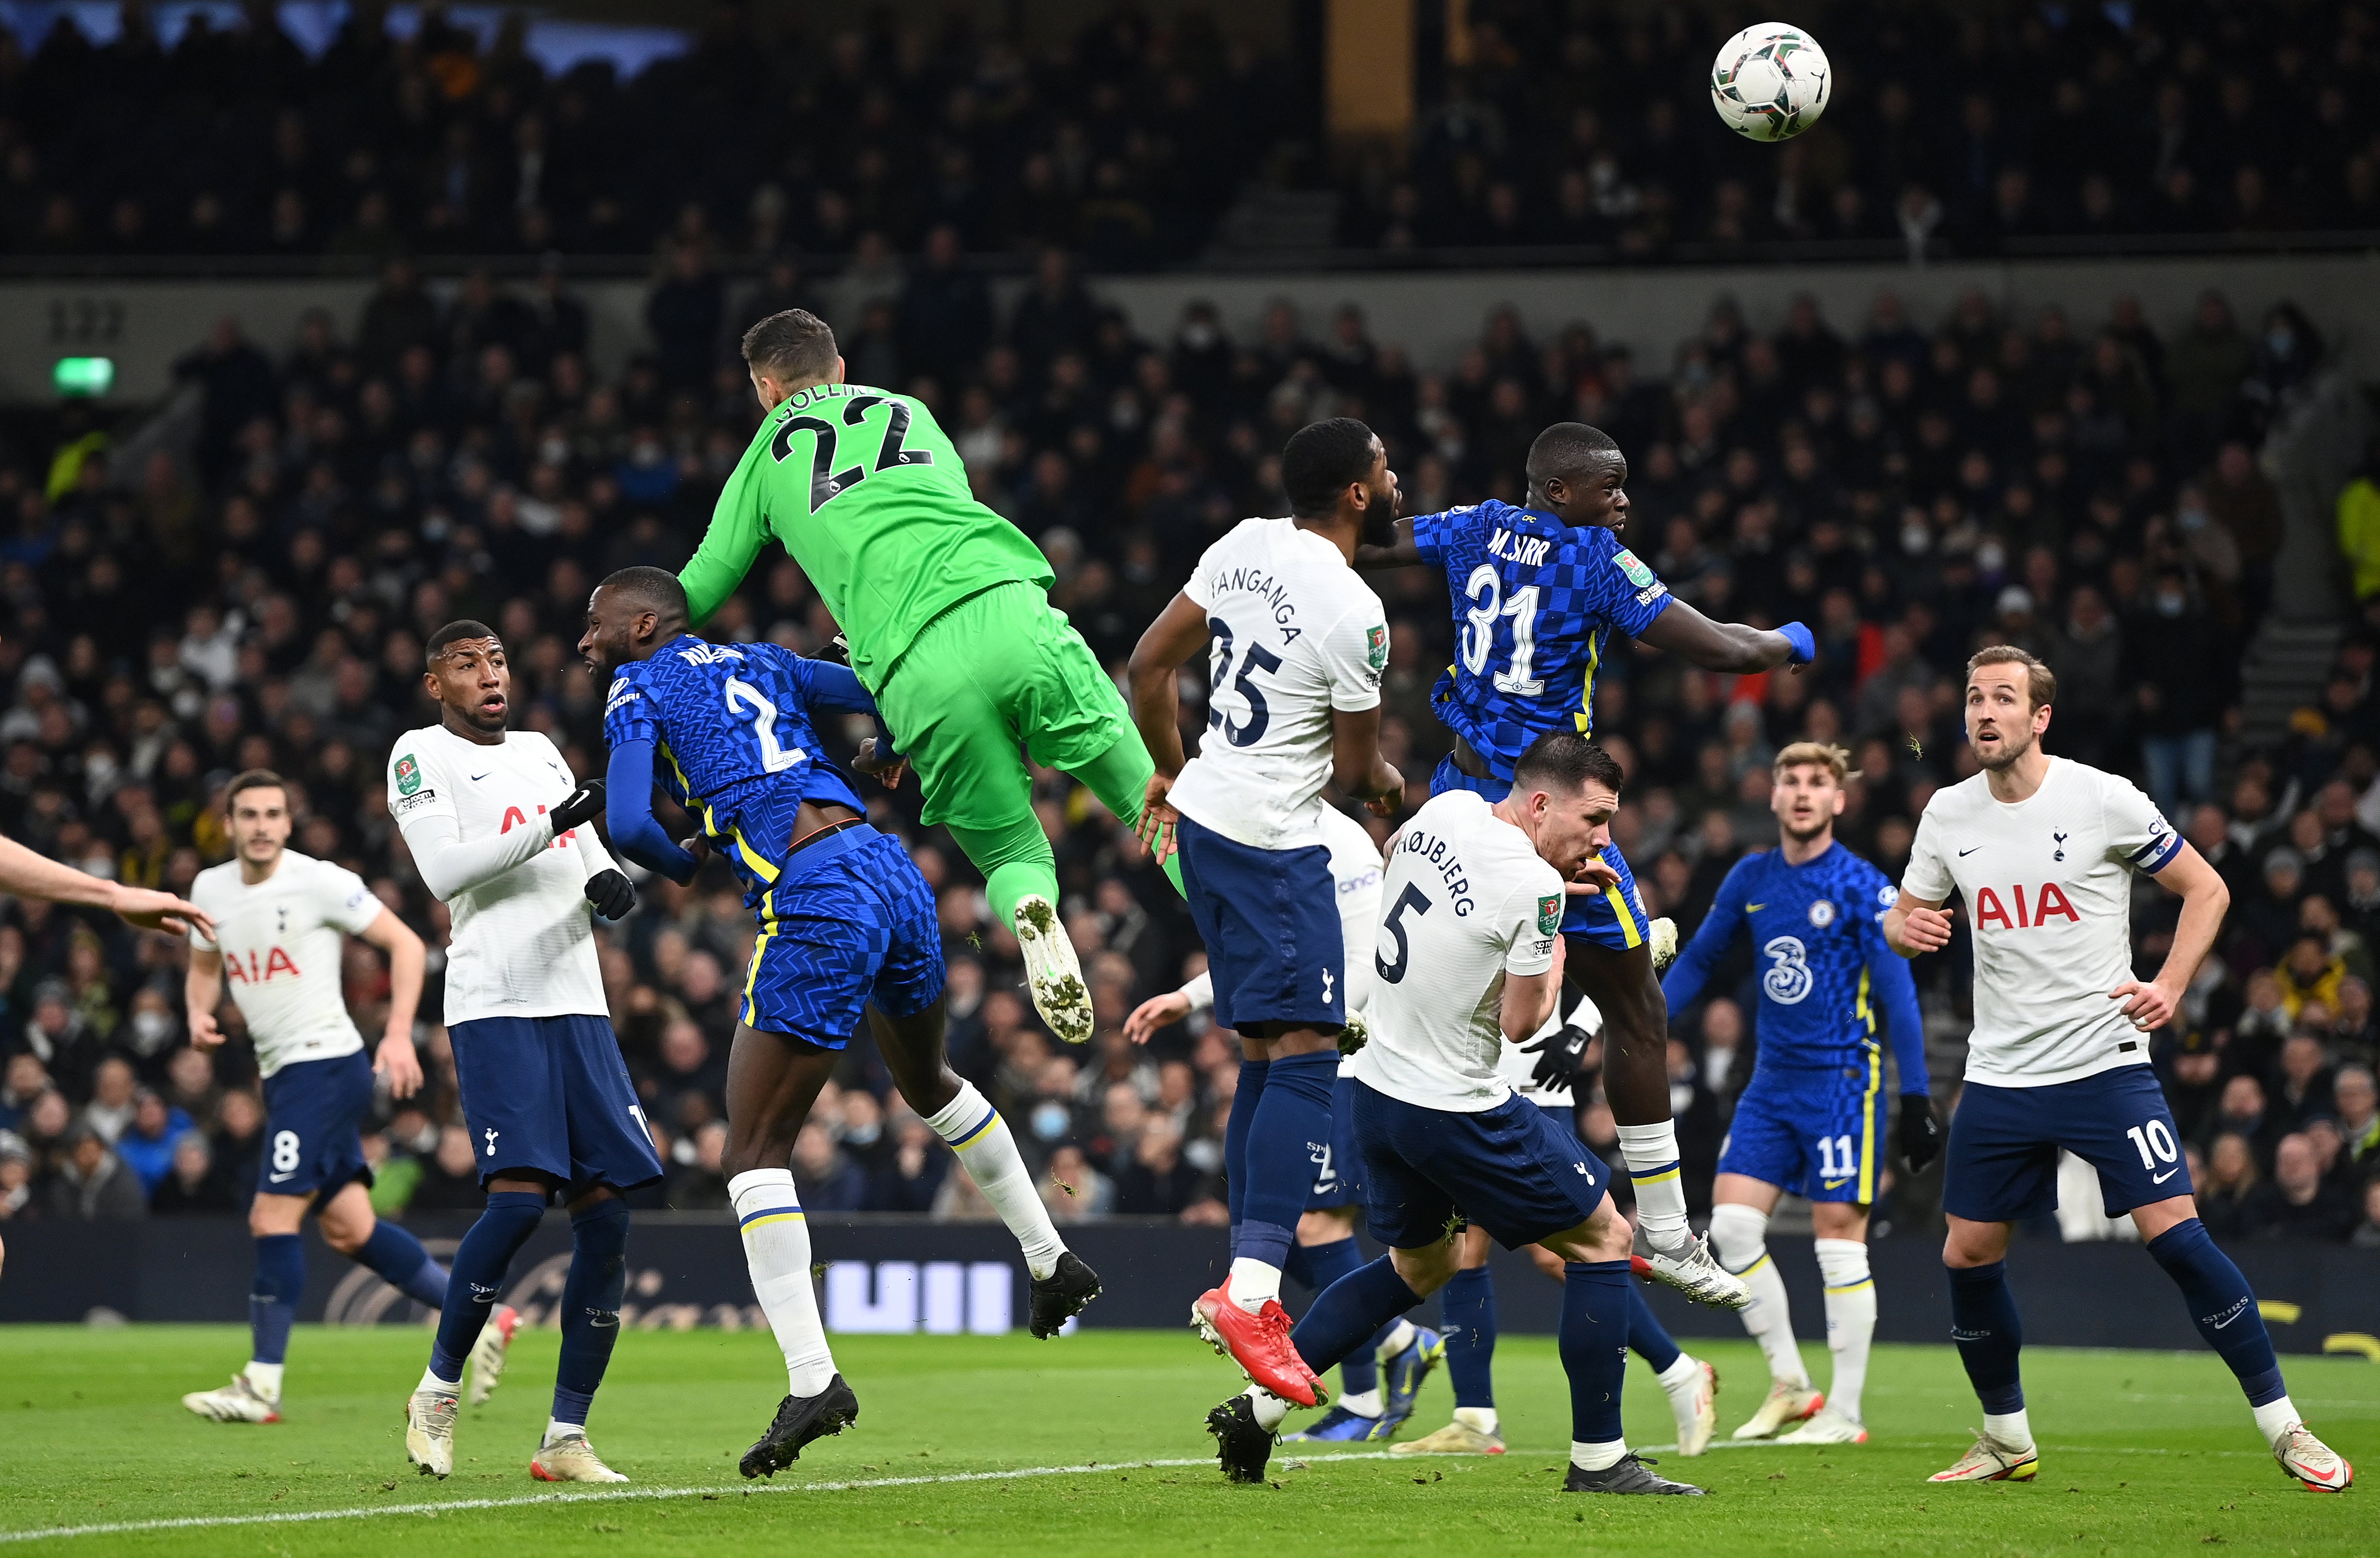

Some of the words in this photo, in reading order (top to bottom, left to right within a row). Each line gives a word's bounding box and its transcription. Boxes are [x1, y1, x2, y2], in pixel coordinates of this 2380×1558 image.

[771, 395, 935, 516] 22
[1522, 515, 1537, 523] CFC
[1211, 567, 1301, 646] TANGANGA
[1461, 563, 1545, 696] 31
[1209, 617, 1283, 747] 25
[725, 675, 807, 773] 2
[410, 791, 432, 803] room
[1396, 831, 1474, 917] HØJBJERG
[1977, 882, 2080, 929] AIA
[1375, 880, 1433, 984] 5
[227, 946, 300, 984] AIA
[272, 1130, 300, 1173] 8
[1817, 1134, 1857, 1178] 11
[2127, 1120, 2177, 1170] 10
[2202, 1296, 2248, 1324] SPURS
